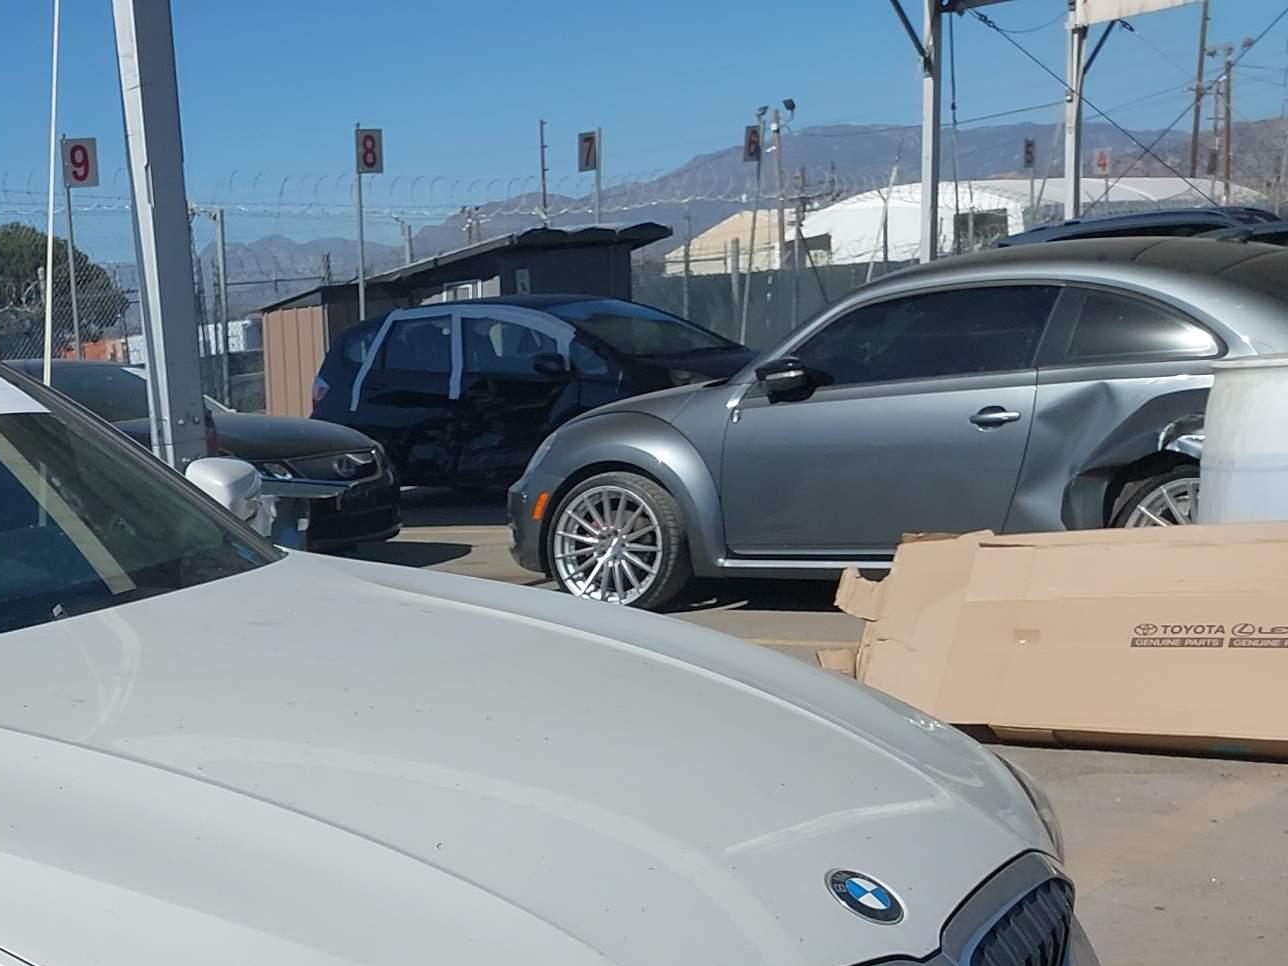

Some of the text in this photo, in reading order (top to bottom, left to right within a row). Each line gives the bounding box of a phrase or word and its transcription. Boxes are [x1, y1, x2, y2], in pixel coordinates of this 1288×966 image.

[70, 144, 89, 182] 9
[362, 134, 377, 169] 8
[583, 136, 594, 167] 7
[1097, 151, 1107, 172] 4
[1135, 638, 1181, 647] GENUINE
[1184, 638, 1221, 647] PARTS
[1233, 638, 1280, 647] GENUINE
[1160, 624, 1226, 635] TOYOTA
